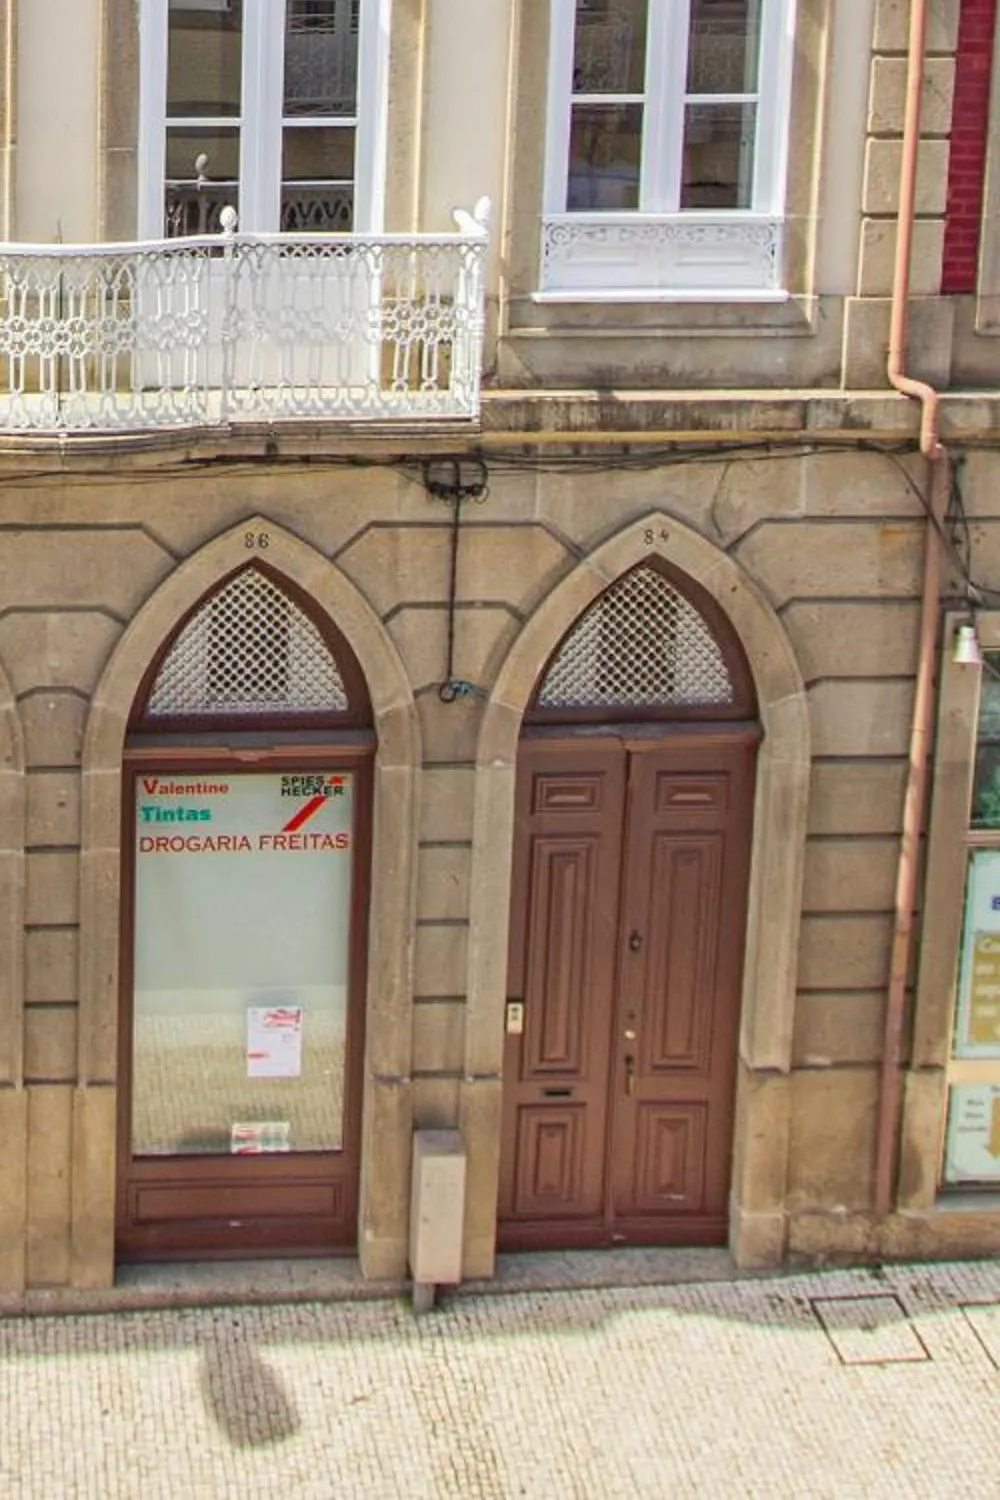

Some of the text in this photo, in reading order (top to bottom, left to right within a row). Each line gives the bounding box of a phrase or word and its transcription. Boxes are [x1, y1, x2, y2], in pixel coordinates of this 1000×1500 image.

[244, 532, 270, 549] 86
[143, 778, 229, 796] Valentine
[281, 775, 325, 786] SPIES
[281, 786, 345, 797] HECKER
[141, 806, 212, 823] Tintas
[139, 833, 349, 853] DROGARIA FREITAS
